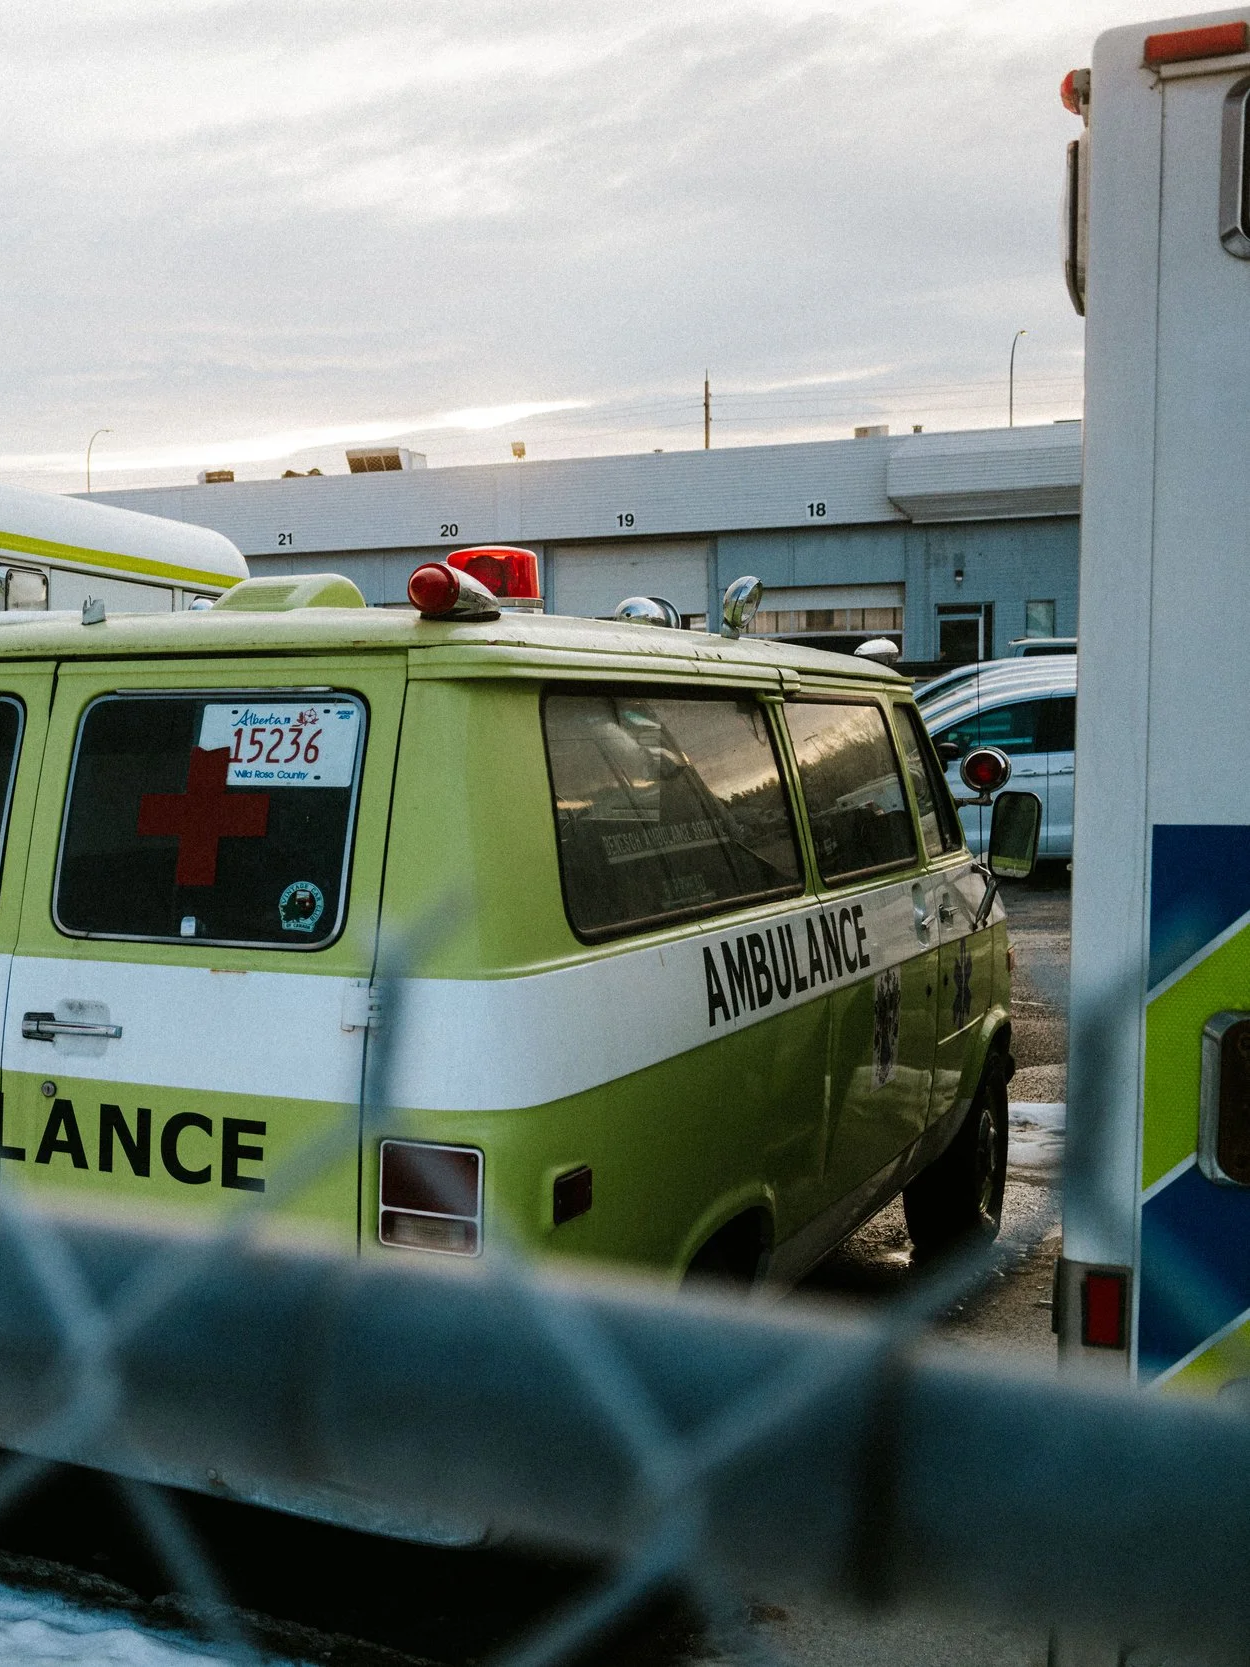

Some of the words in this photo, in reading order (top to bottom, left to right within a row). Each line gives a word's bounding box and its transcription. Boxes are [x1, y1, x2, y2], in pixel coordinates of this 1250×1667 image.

[807, 502, 826, 517] 18
[616, 513, 634, 527] 19
[440, 524, 458, 537] 20
[278, 533, 293, 546] 21
[231, 709, 283, 727] Alberta
[229, 728, 322, 764] 15236
[234, 770, 252, 778] Wild
[254, 770, 274, 778] Rose
[277, 770, 308, 780] Country
[282, 883, 308, 904] VINTAGE
[702, 904, 870, 1027] AMBULANCE
